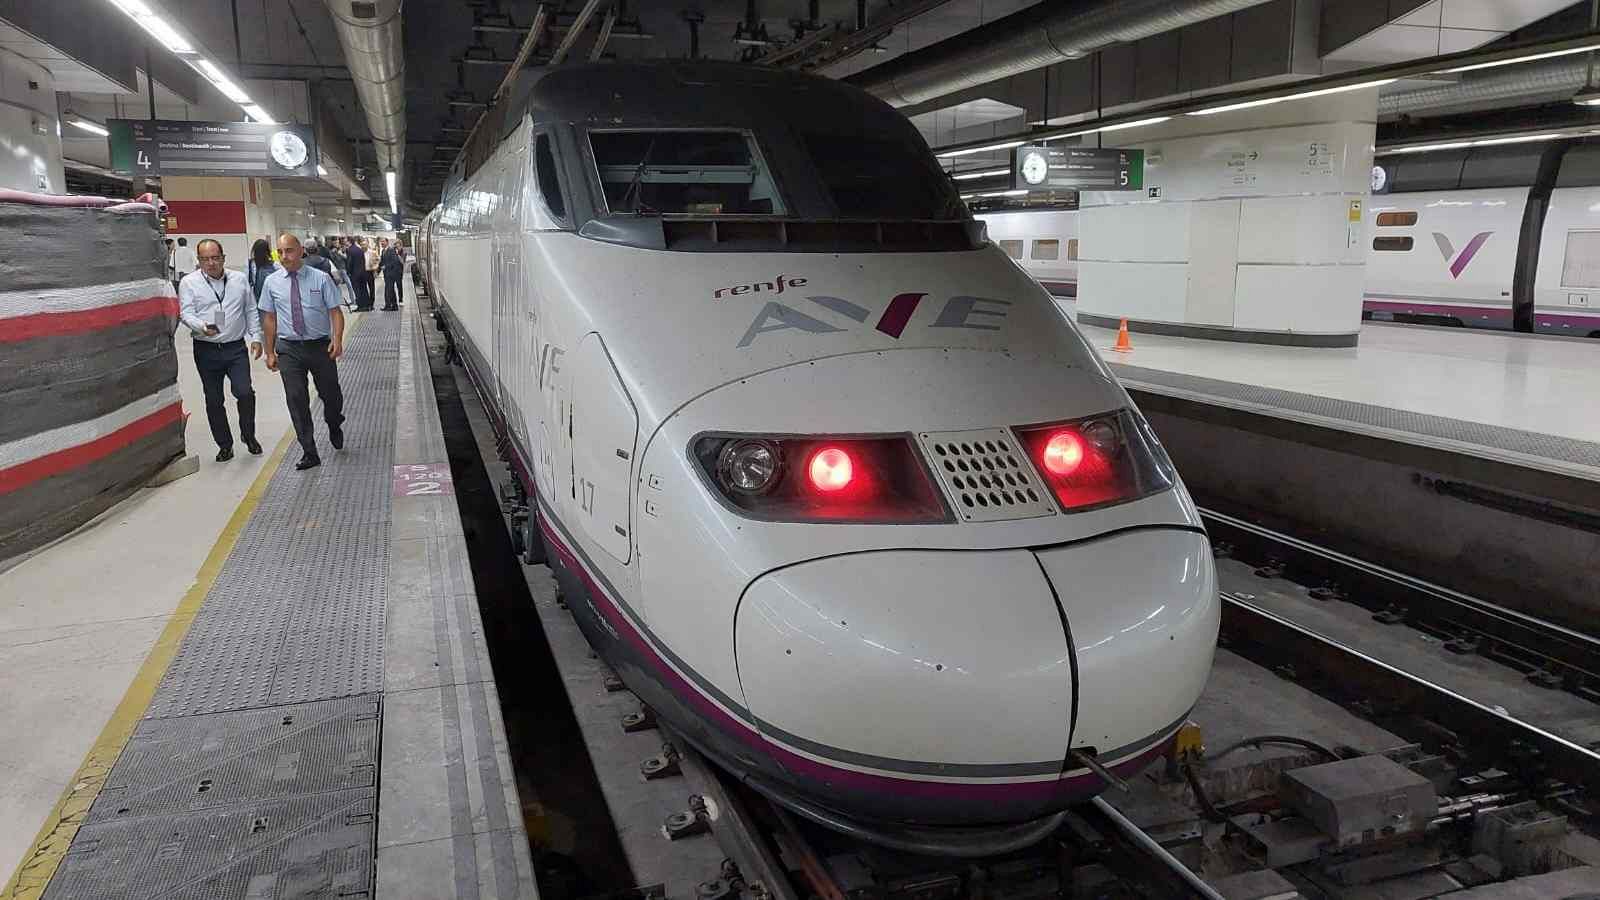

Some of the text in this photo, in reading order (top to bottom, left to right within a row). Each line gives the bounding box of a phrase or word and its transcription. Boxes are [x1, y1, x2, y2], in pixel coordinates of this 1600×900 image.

[137, 151, 152, 170] 4
[1120, 170, 1128, 185] 5
[714, 273, 809, 298] renfe
[736, 293, 1012, 348] AVE
[580, 478, 595, 516] 17
